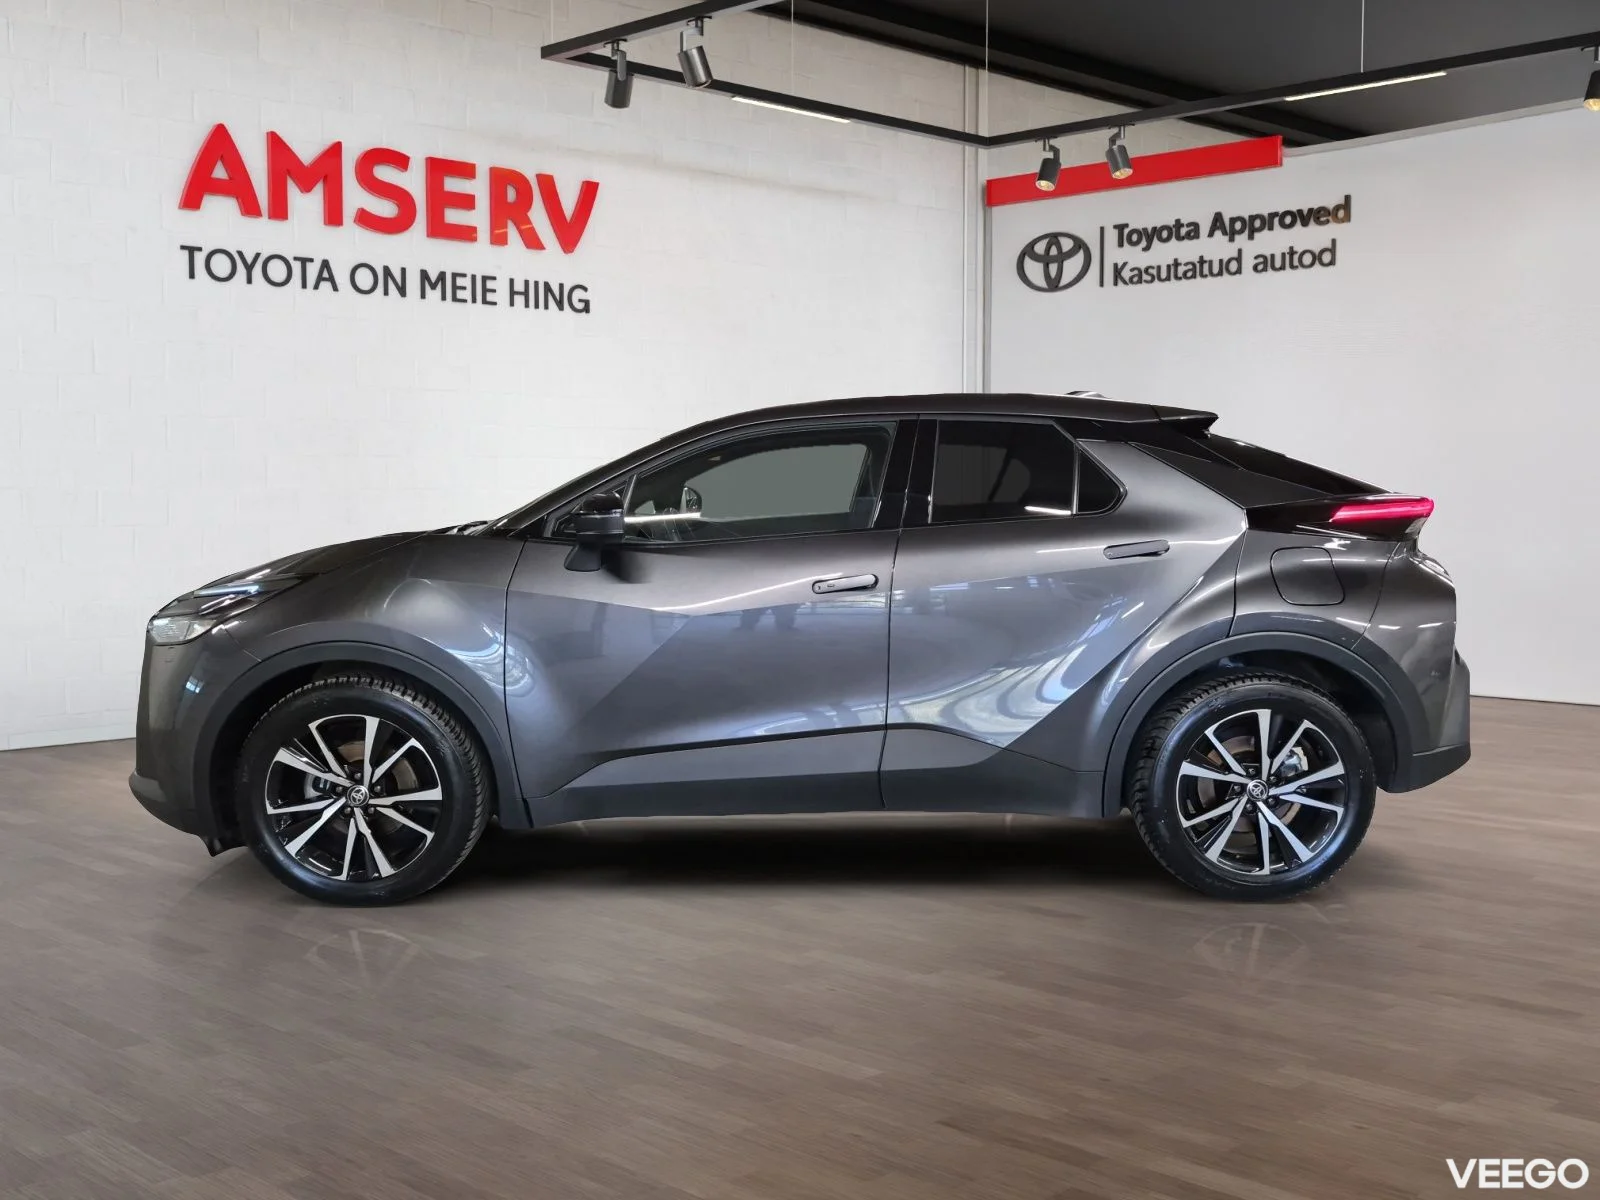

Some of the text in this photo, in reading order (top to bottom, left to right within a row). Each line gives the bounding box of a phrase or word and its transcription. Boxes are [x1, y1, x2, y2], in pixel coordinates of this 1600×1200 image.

[178, 123, 600, 254] AMSERV
[1112, 194, 1352, 252] Toyota Approved
[180, 245, 591, 314] TOYOTA ON MEIE HING
[1112, 238, 1337, 286] Kasutatud autod
